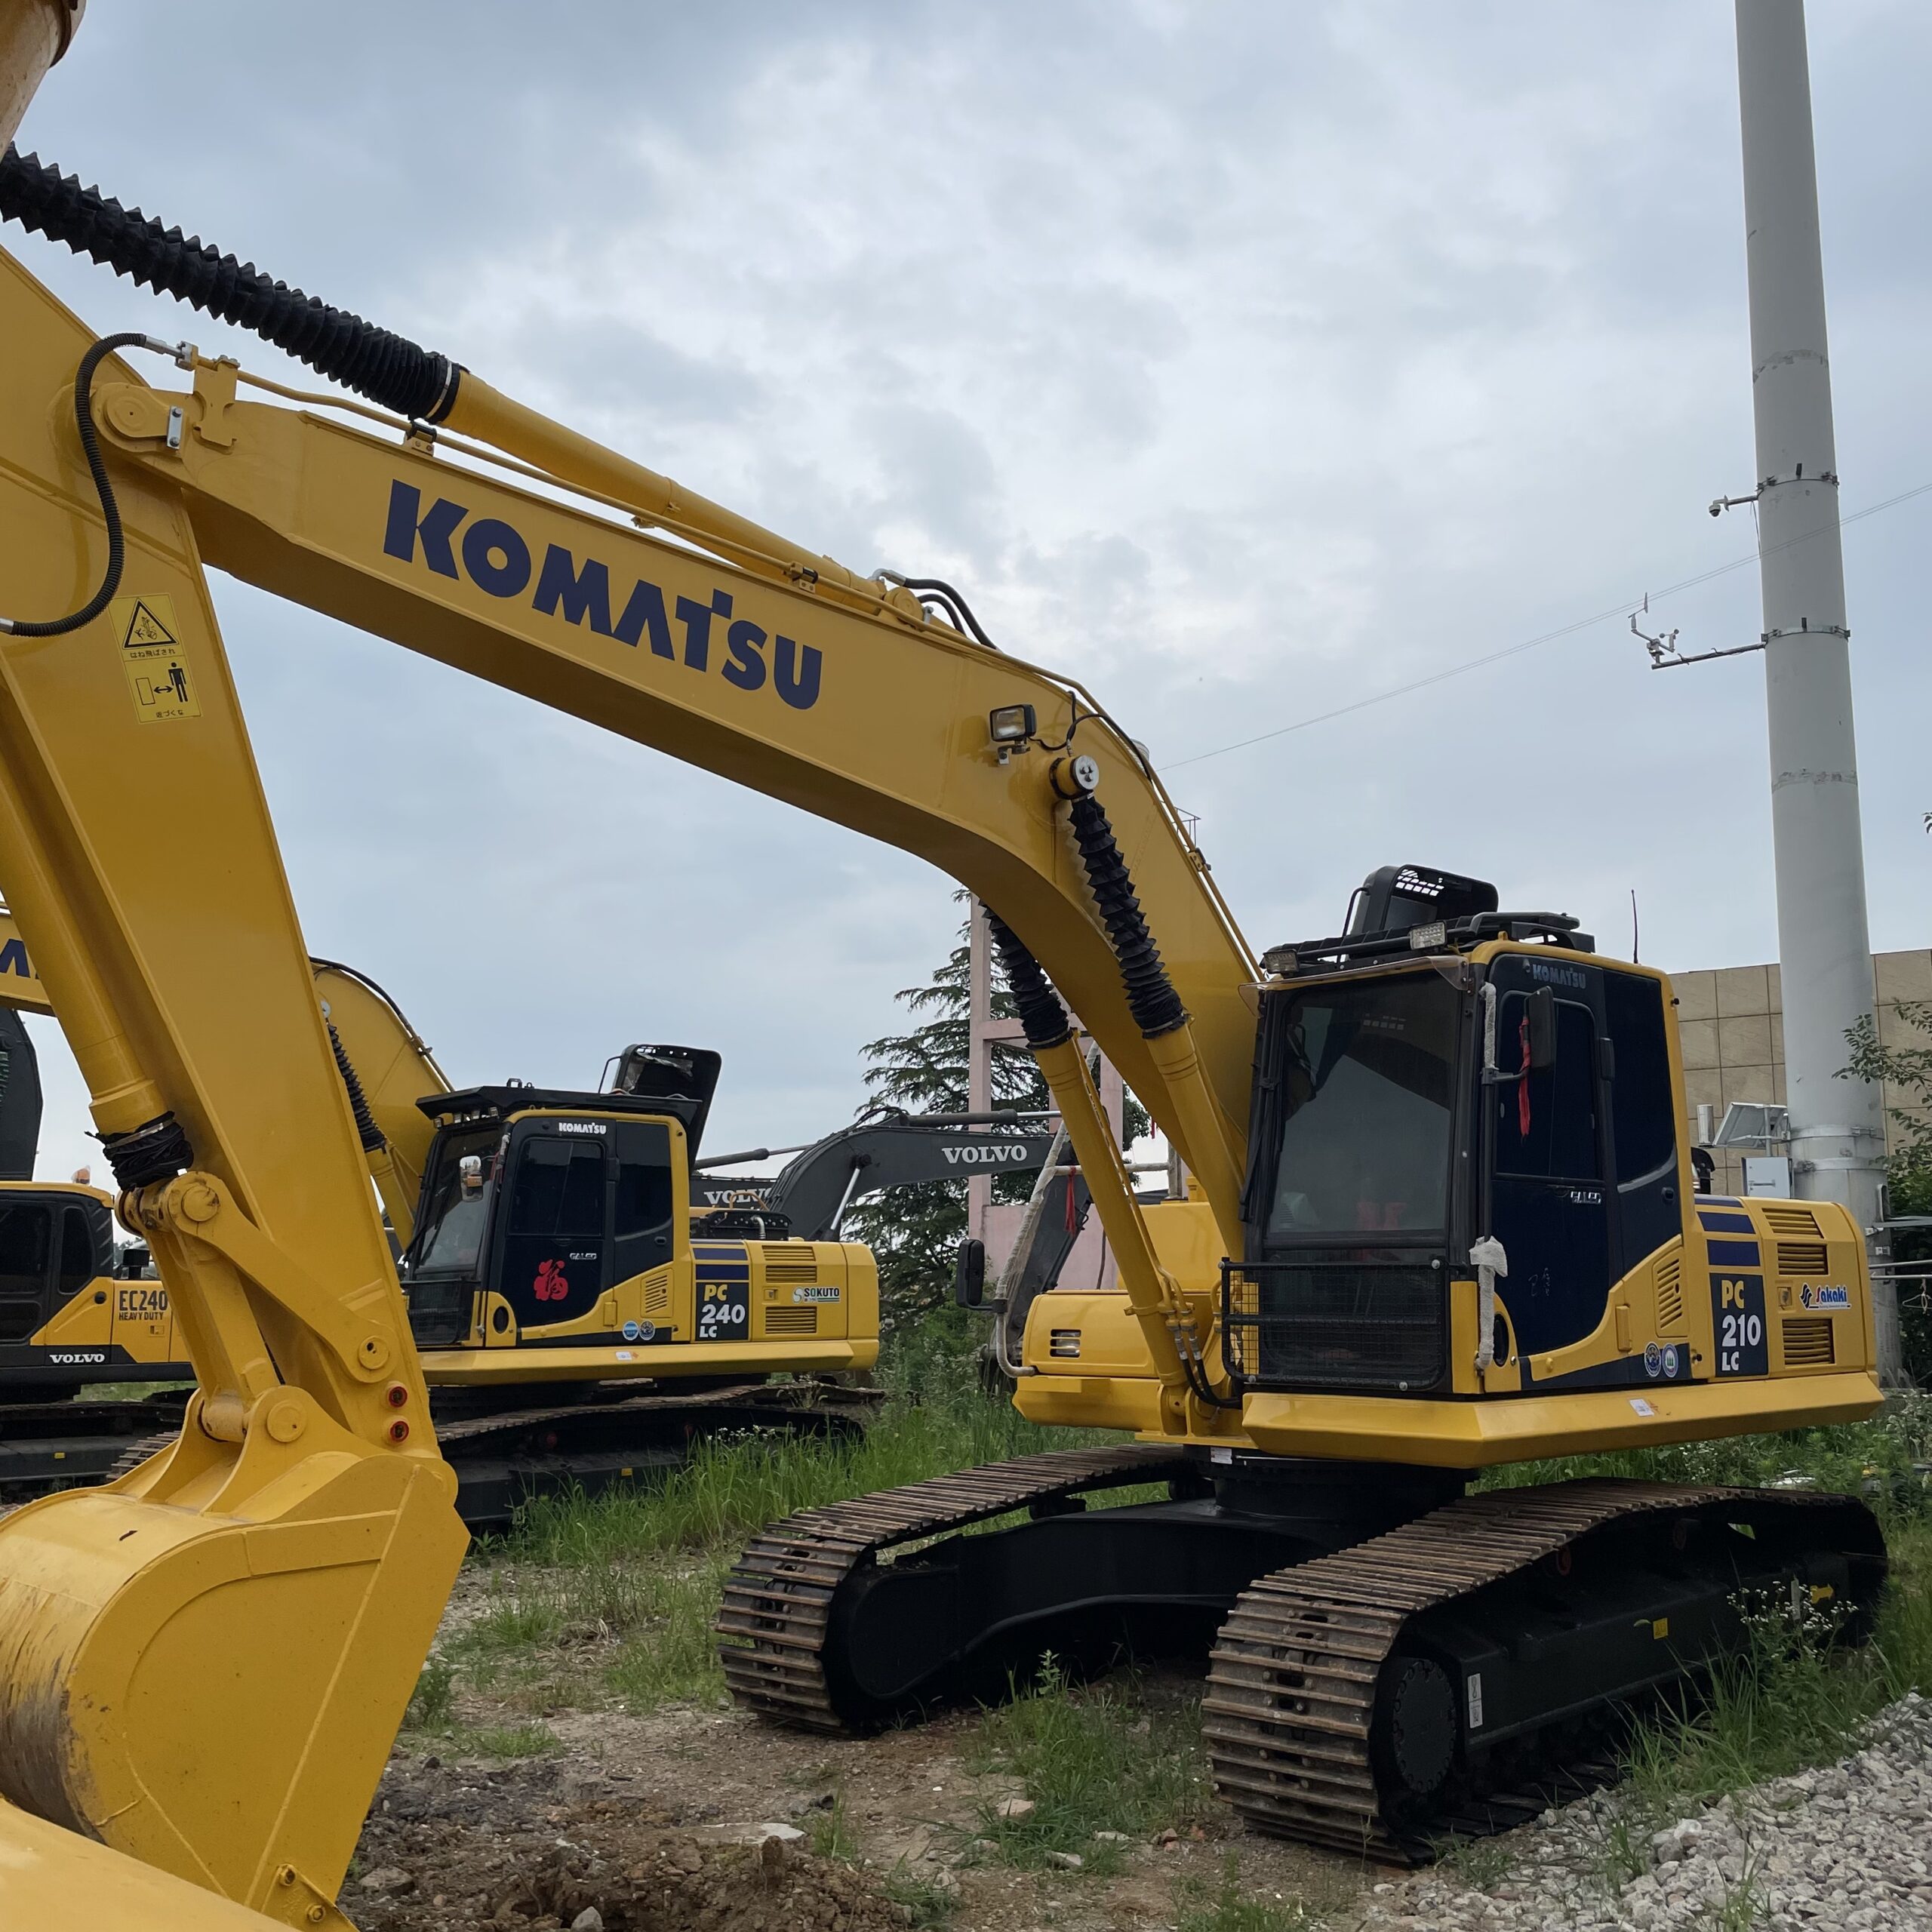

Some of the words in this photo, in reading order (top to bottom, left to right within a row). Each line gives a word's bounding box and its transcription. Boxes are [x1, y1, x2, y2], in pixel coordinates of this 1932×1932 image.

[383, 478, 823, 709] KOMATSU
[1532, 964, 1586, 989] KOMATSU
[558, 1122, 607, 1135] KOMATSU
[941, 1145, 1027, 1164] VOLVO
[119, 1290, 168, 1312] EC240
[703, 1284, 728, 1302] PC
[804, 1287, 840, 1297] SOKUTO
[1721, 1280, 1745, 1309] PC
[1816, 1286, 1847, 1303] Sakaki
[118, 1312, 143, 1321] HEAVY
[143, 1312, 164, 1321] DUTY
[700, 1303, 746, 1324] 240
[699, 1325, 718, 1338] LC
[1721, 1314, 1761, 1347] 210
[49, 1353, 105, 1364] VOLVO
[1721, 1351, 1740, 1371] LC
